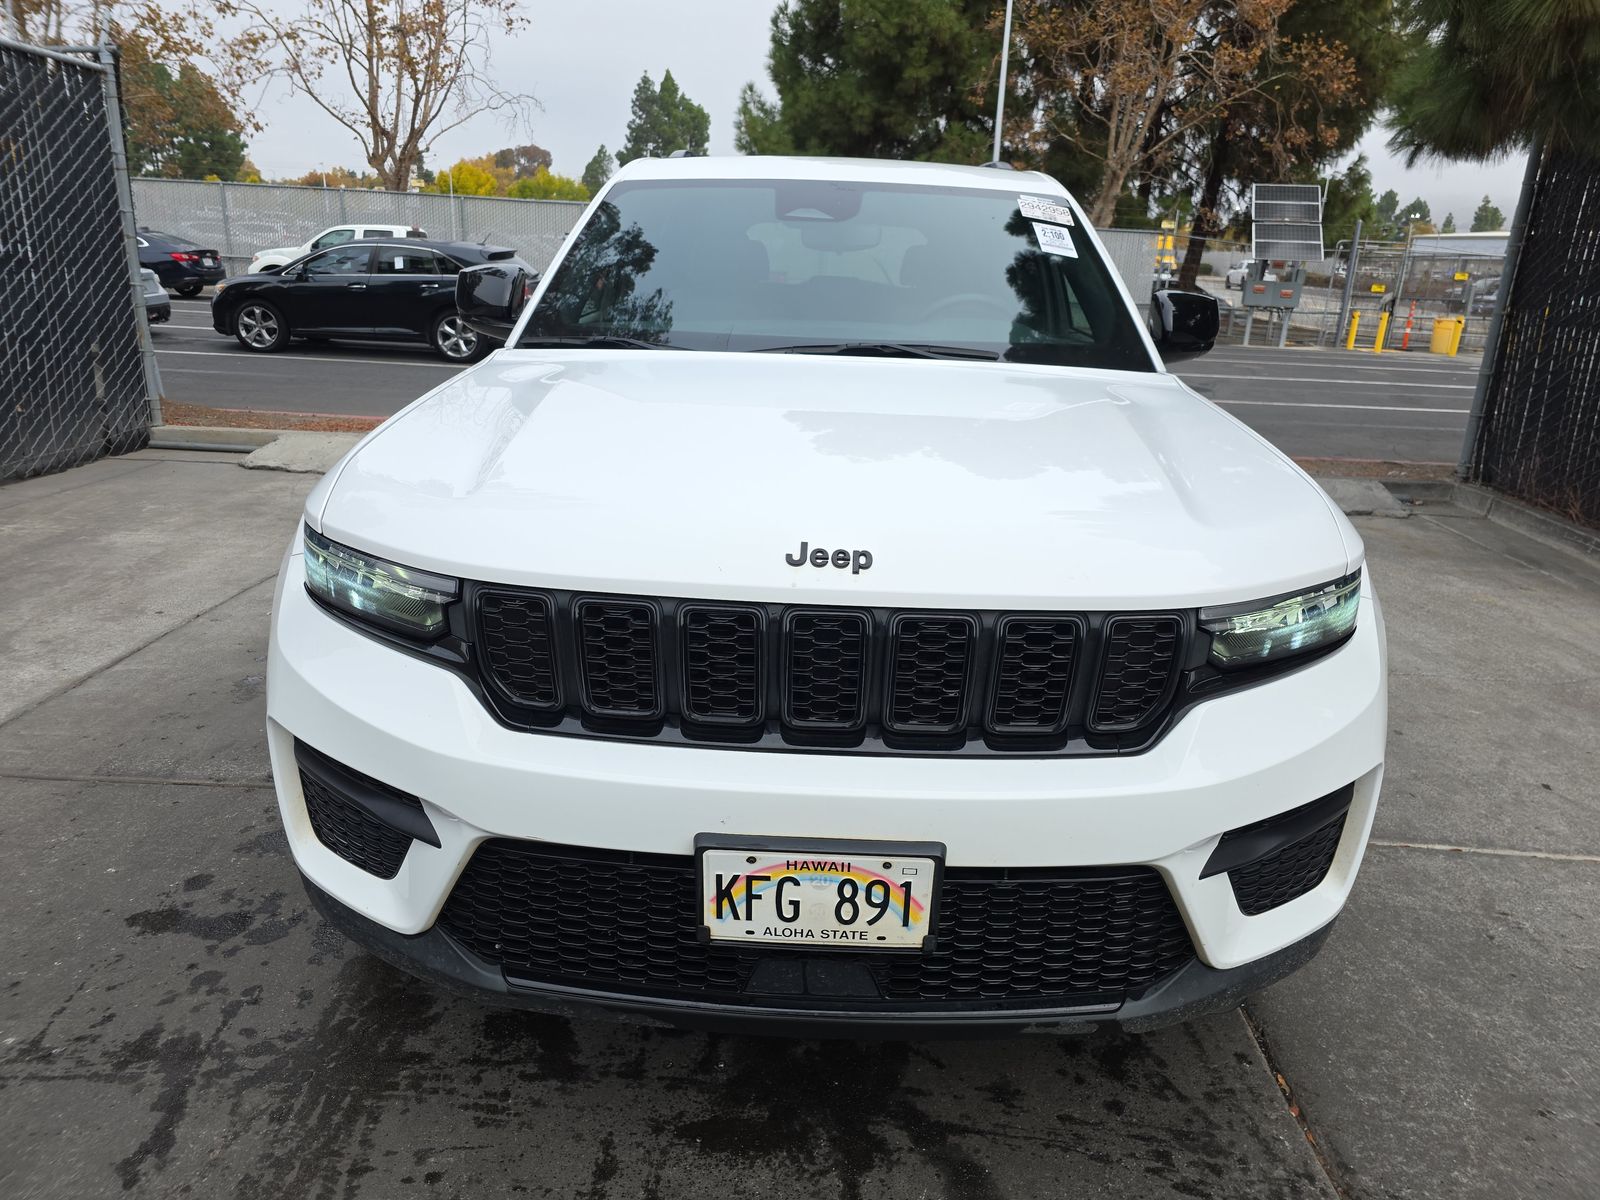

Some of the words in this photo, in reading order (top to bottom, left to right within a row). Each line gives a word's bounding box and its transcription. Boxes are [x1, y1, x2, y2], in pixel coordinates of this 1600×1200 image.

[785, 541, 873, 575] Jeep
[786, 860, 852, 873] HAWAII
[715, 873, 801, 923] KFG
[834, 878, 913, 928] 891
[763, 927, 815, 939] ALOHA
[820, 929, 869, 941] STATE
